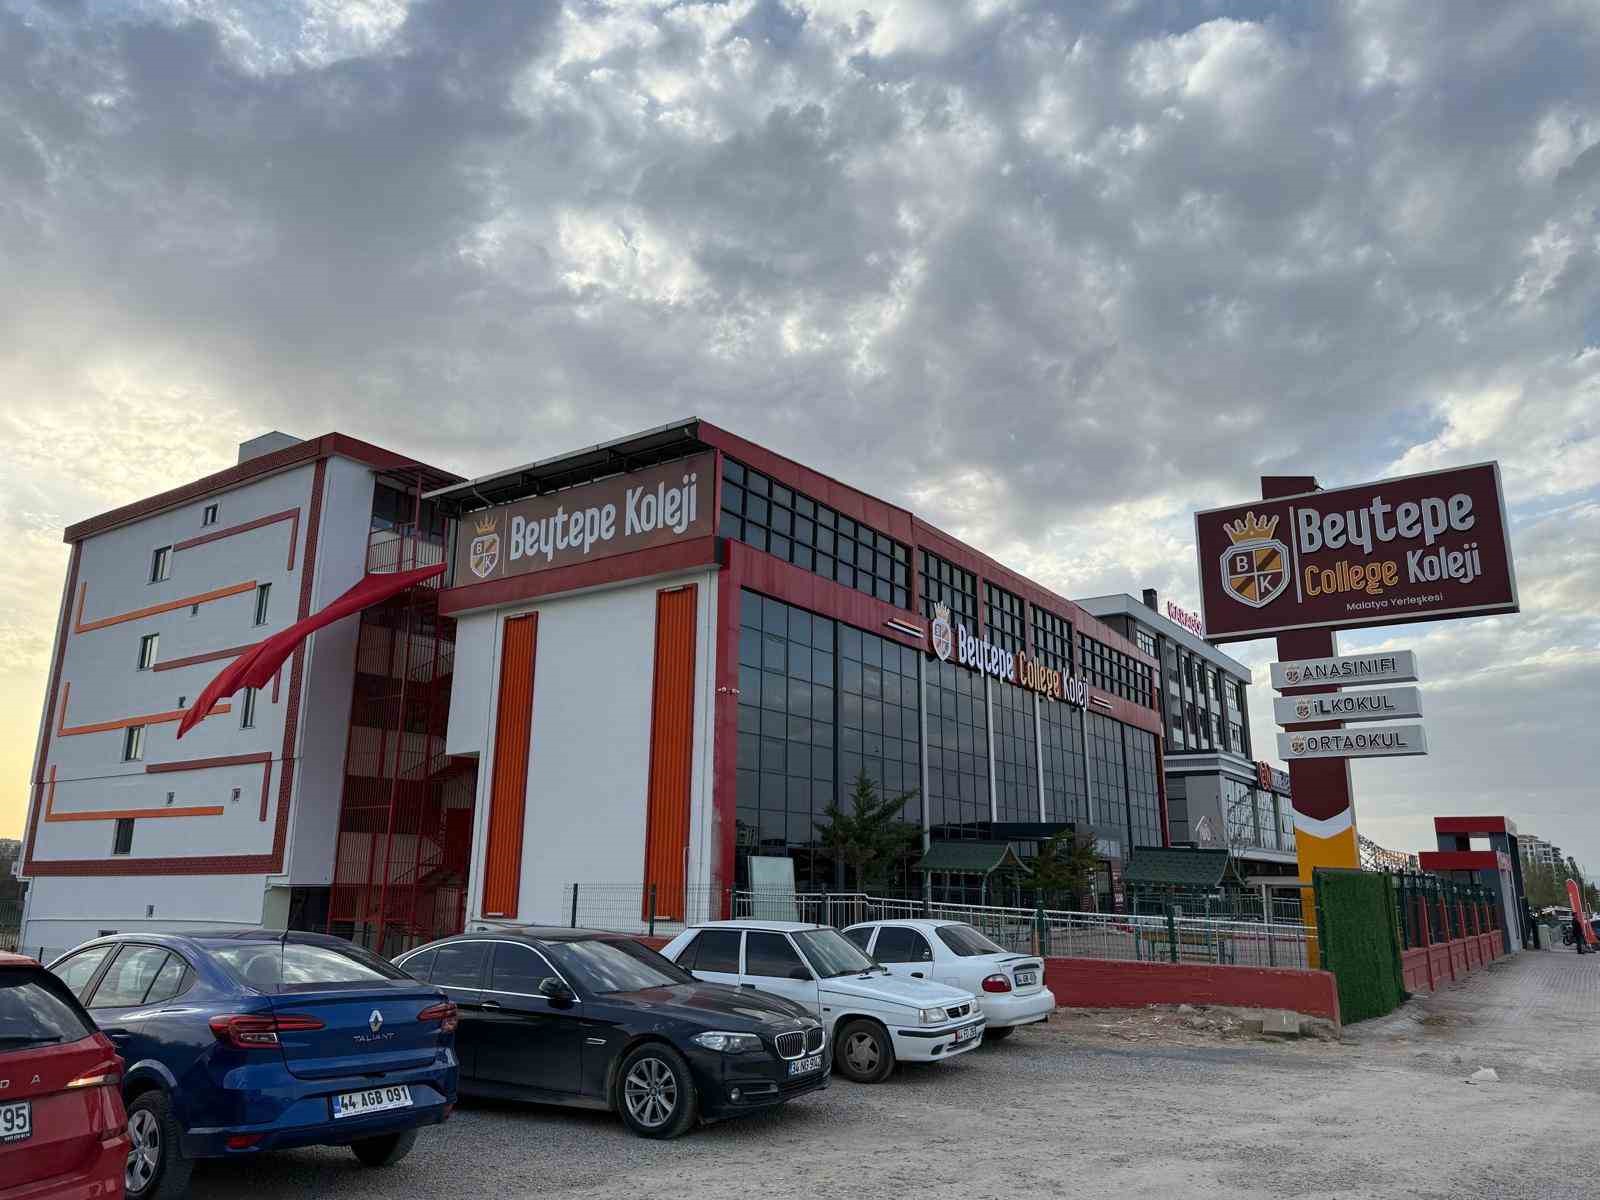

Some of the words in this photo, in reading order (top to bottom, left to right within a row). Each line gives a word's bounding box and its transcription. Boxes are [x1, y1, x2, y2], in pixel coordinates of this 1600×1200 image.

[510, 503, 616, 562] Beytepe
[624, 472, 698, 536] Koleji
[1298, 493, 1475, 554] Beytepe
[1235, 556, 1249, 572] B
[1304, 559, 1398, 595] College
[1406, 542, 1482, 584] Koleji
[1259, 575, 1273, 593] K
[1346, 600, 1388, 611] Malatya
[958, 624, 1014, 684] Beytepe
[1018, 651, 1060, 702] College
[1063, 668, 1089, 712] Koleji
[1303, 657, 1397, 679] ANASINIFI
[1307, 732, 1407, 751] ORTAOKUL
[340, 1095, 357, 1111] 44
[361, 1090, 383, 1108] AGB
[386, 1087, 408, 1102] 091
[0, 1105, 27, 1132] 95
